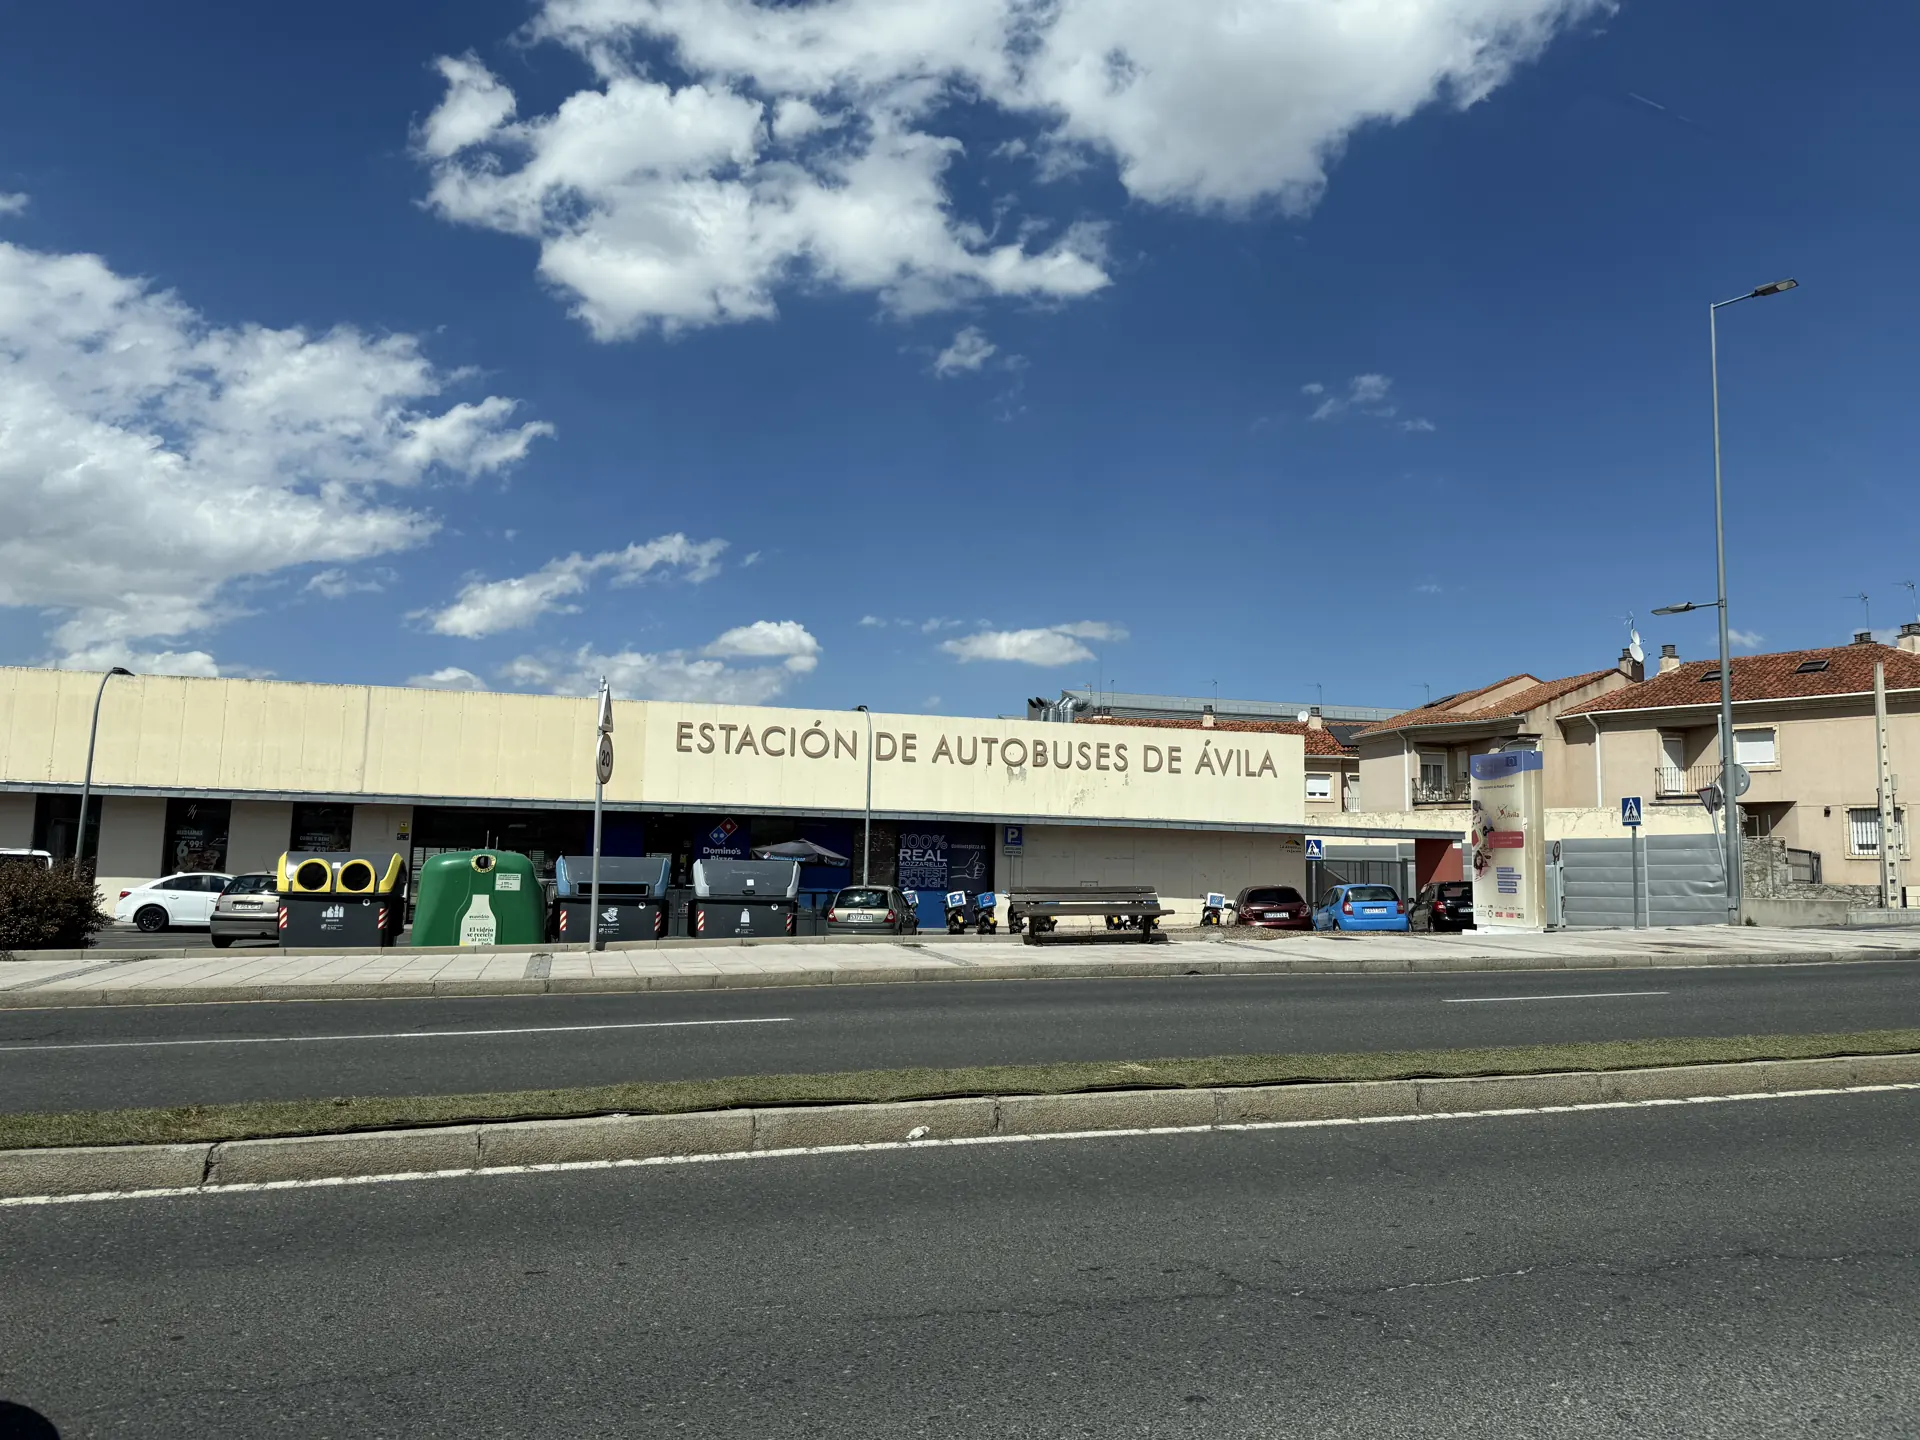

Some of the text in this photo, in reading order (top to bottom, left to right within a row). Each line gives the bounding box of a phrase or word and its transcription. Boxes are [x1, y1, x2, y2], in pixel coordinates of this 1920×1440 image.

[675, 719, 1278, 778] ESTACIÓN DE AUTOBUSES DE ÁVILA
[601, 749, 610, 767] 20
[899, 833, 948, 850] 100%
[1007, 828, 1018, 843] P
[702, 846, 741, 855] Domino's
[899, 849, 948, 861] REAL
[910, 869, 948, 878] FRESH
[898, 877, 948, 888] DOUGH
